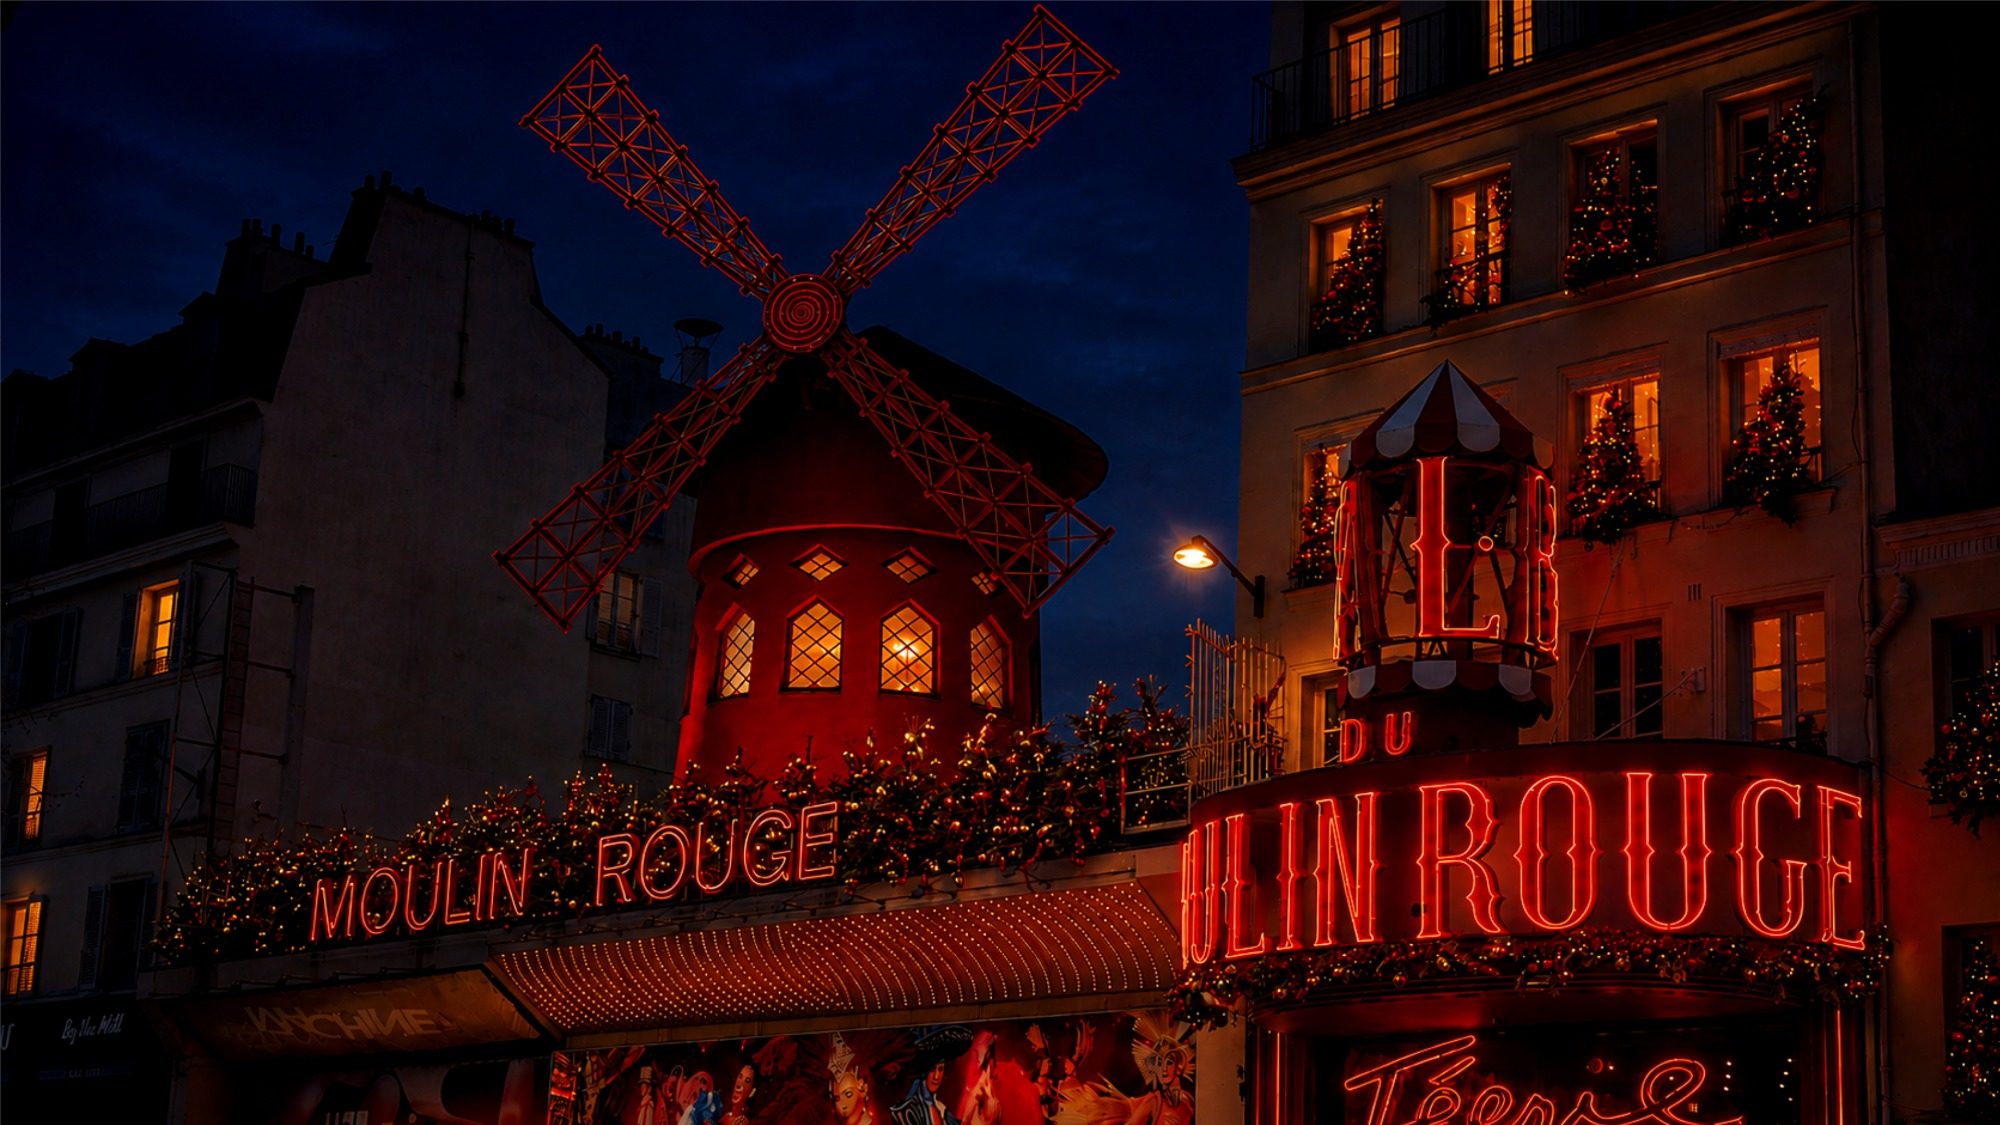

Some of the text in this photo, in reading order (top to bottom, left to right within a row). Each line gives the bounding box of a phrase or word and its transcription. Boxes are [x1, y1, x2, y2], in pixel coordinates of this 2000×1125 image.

[1338, 709, 1415, 766] DU
[308, 800, 839, 943] MOULIN ROUGE
[1181, 771, 1867, 971] ULIN ROUGE
